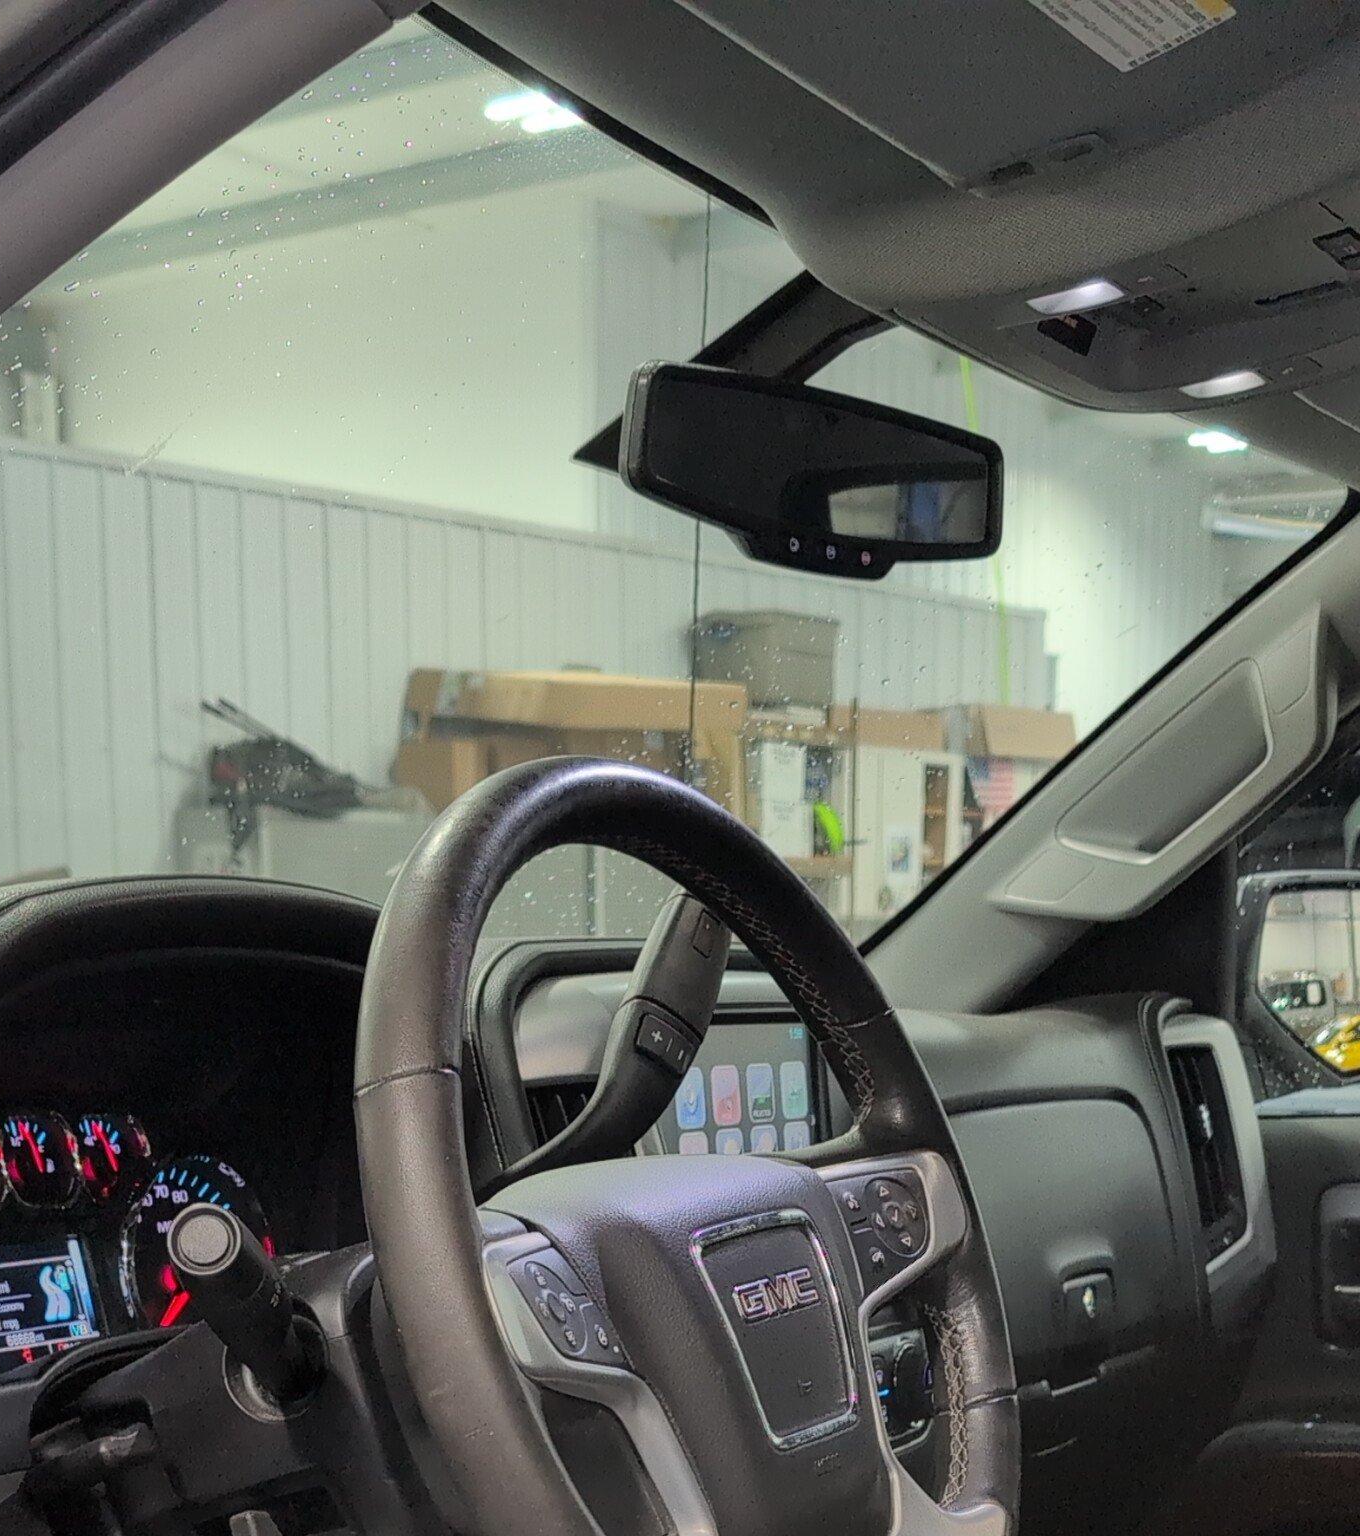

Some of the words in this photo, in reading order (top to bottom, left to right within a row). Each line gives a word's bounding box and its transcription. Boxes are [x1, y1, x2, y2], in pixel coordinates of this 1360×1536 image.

[153, 1184, 169, 1199] 70
[171, 1190, 189, 1204] 80
[732, 1268, 821, 1321] GMC
